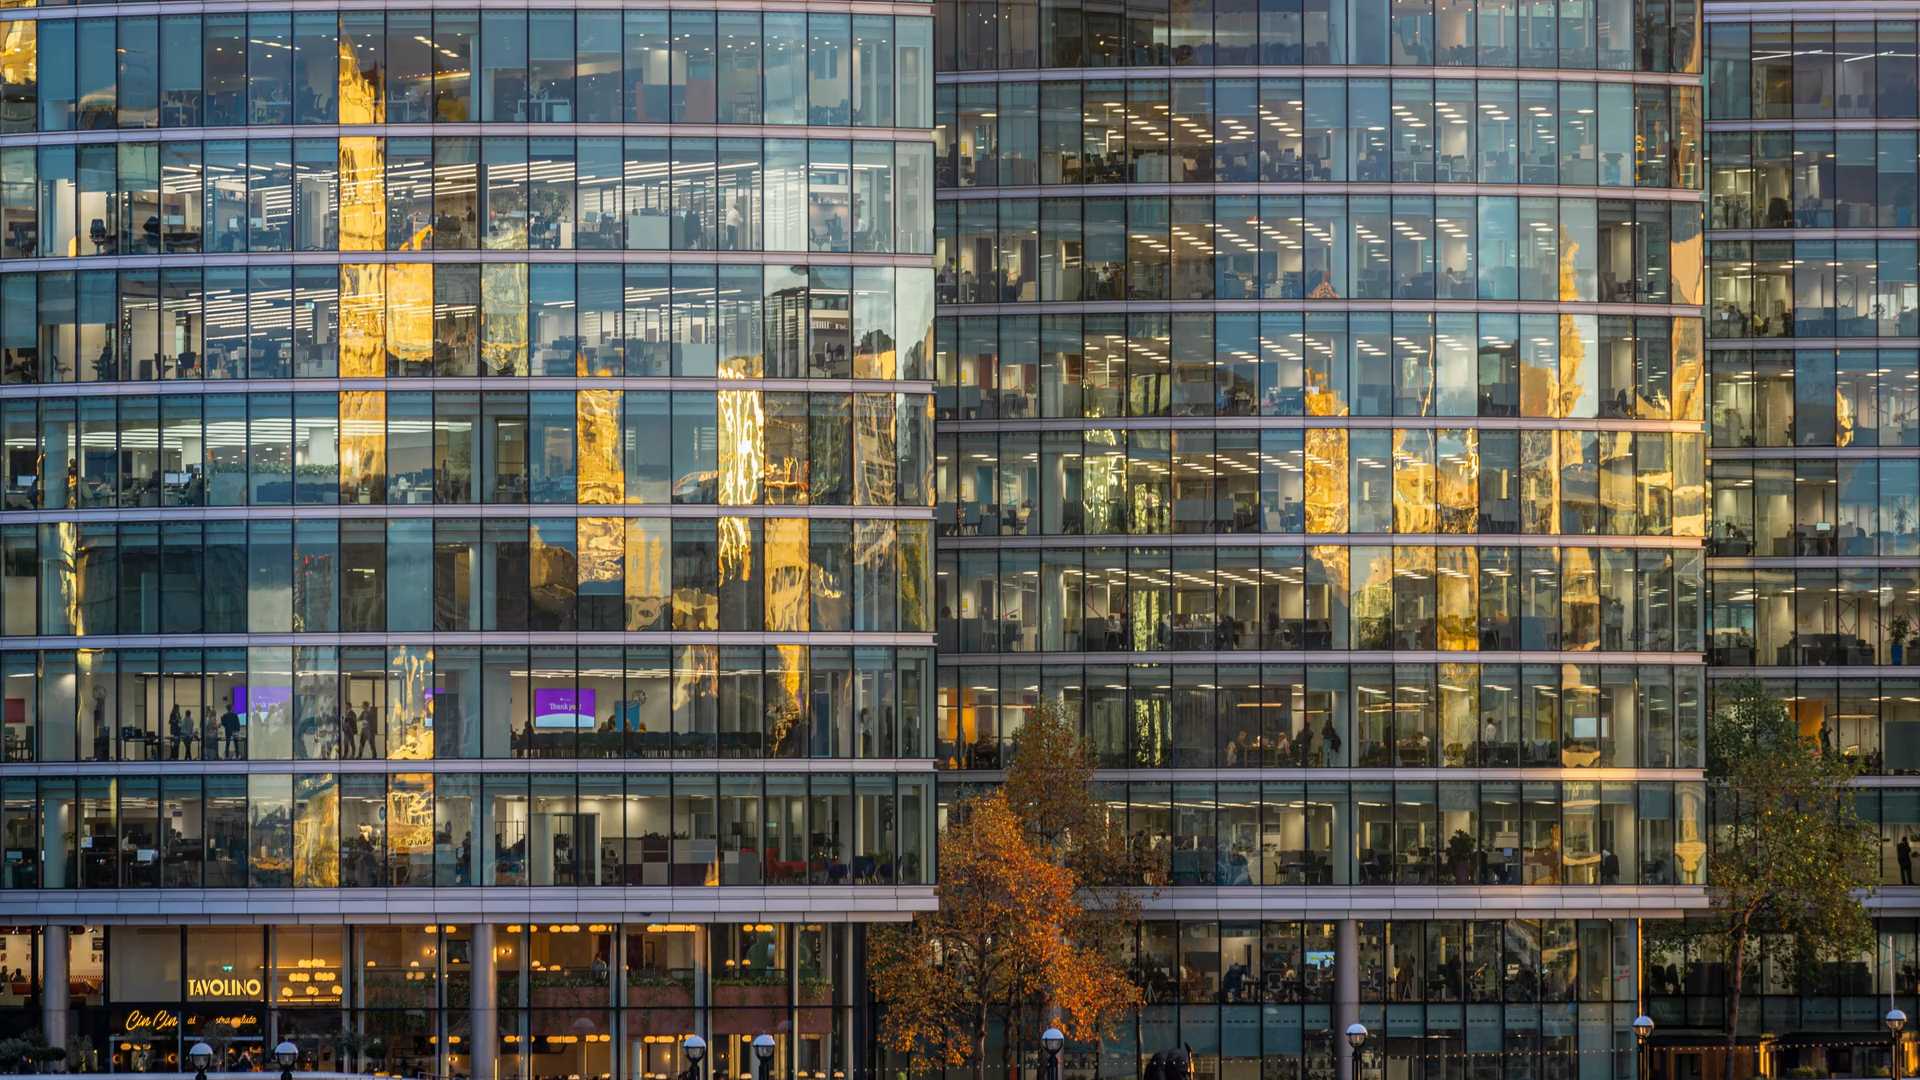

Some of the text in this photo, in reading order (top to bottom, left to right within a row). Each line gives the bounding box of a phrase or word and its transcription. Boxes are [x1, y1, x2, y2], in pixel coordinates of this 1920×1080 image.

[549, 702, 568, 711] Thank
[188, 979, 261, 996] TAVOLINO
[126, 1010, 151, 1031] Cin
[153, 1010, 178, 1031] Cin
